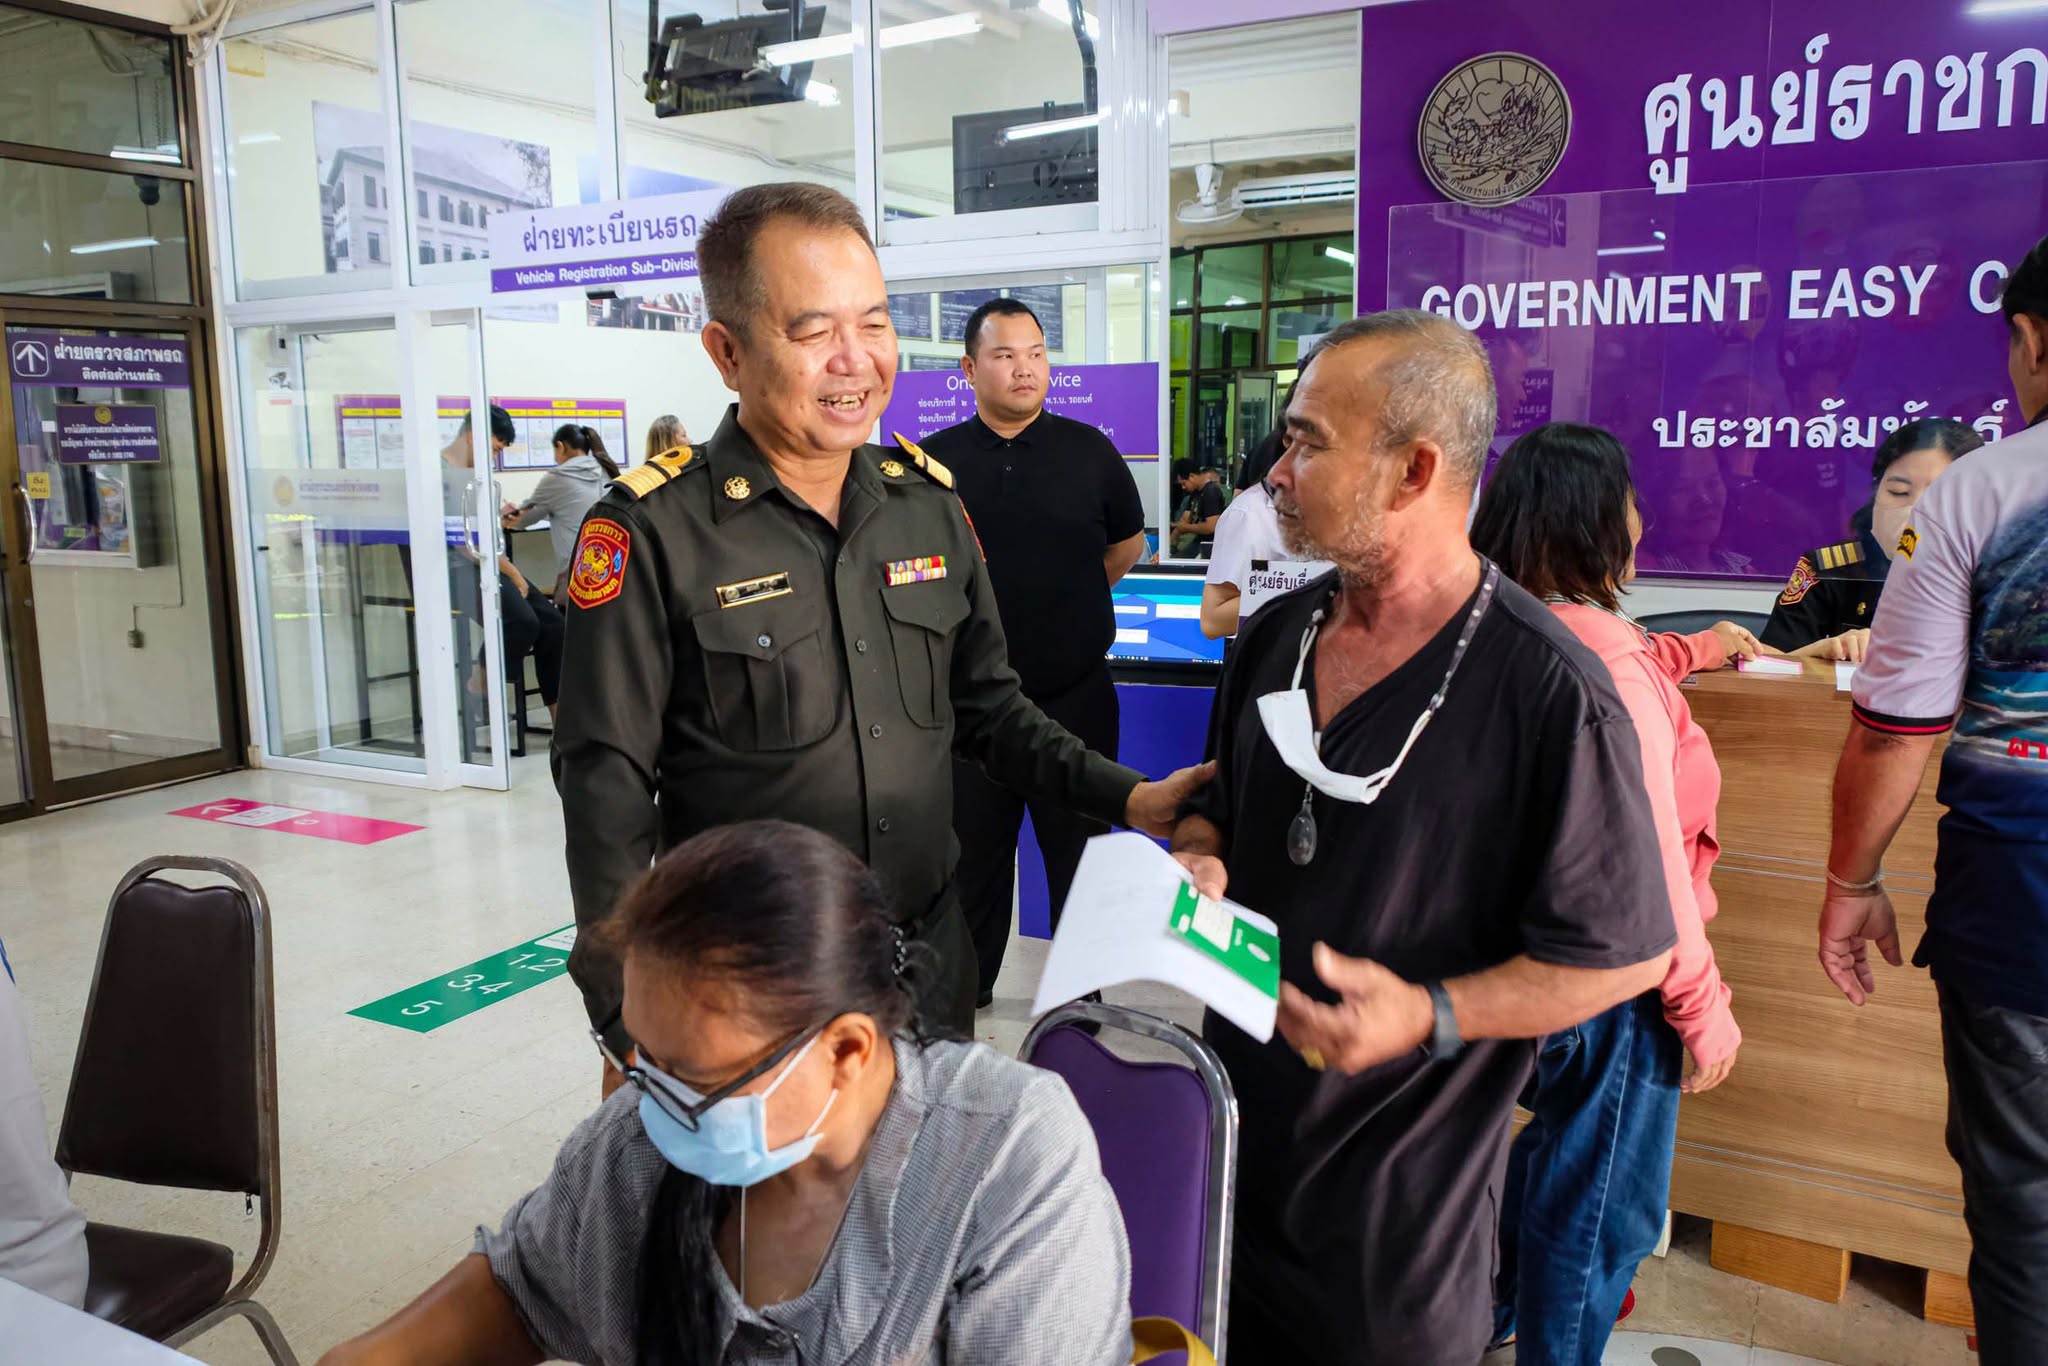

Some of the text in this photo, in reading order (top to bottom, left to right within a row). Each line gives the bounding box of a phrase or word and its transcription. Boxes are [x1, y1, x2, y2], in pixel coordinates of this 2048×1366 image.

[1644, 32, 2048, 195] ศูนย์ราชก
[523, 210, 697, 252] ฝ่ายทะเบียนรถ
[515, 256, 699, 285] Vehicle Registration Sub-Divisi
[1421, 260, 2009, 330] GOVERNMENT EASY C
[54, 338, 184, 362] ฝ่ายตรวจสภาพรถ
[1049, 372, 1081, 387] vice
[1652, 398, 2009, 448] ประชาสัมัธ์
[447, 973, 513, 995] 3,4
[400, 999, 444, 1016] 5
